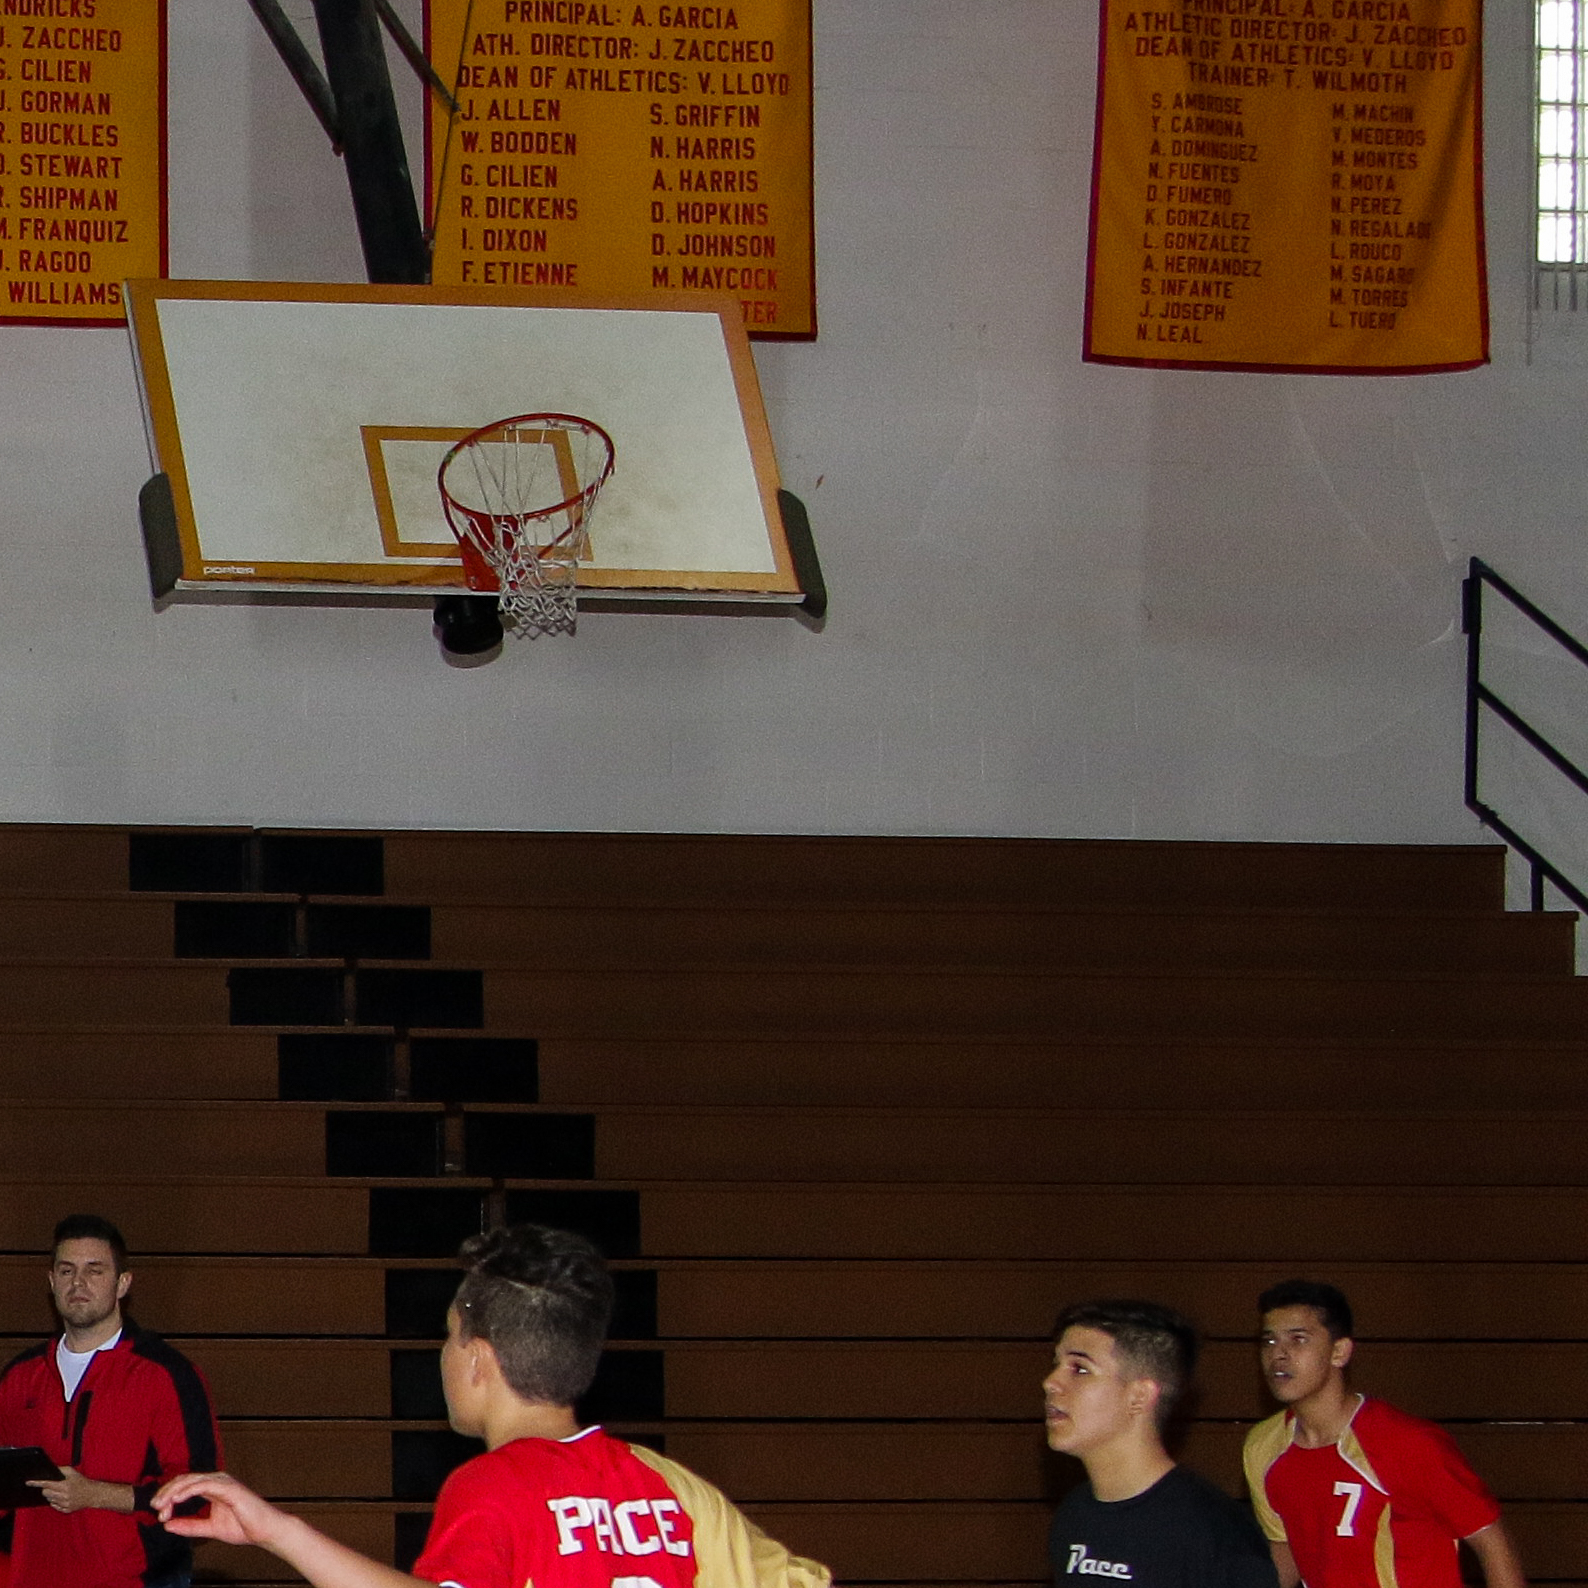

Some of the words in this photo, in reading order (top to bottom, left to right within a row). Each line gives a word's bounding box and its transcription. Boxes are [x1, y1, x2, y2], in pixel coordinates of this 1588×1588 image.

[22, 59, 91, 83] CILIEN
[455, 63, 518, 90] DEAN
[530, 66, 557, 88] OF
[698, 72, 715, 94] V.
[723, 73, 790, 96] LLOYD
[22, 90, 110, 115] GORMAN
[461, 99, 479, 121] J.
[487, 99, 560, 121] ALLEN
[650, 103, 668, 125] S.
[676, 104, 759, 127] GRIFFIN
[21, 122, 118, 147] BUCKLES
[461, 131, 483, 152] W.
[491, 131, 576, 155] BODDEN
[651, 137, 669, 158] N.
[677, 137, 755, 159] HARRIS
[20, 250, 90, 273] RAGOO
[9, 282, 120, 304] WILLIAMS
[1333, 1481, 1363, 1536] 7
[547, 1496, 690, 1557] PACE
[1066, 1544, 1132, 1580] Pace
